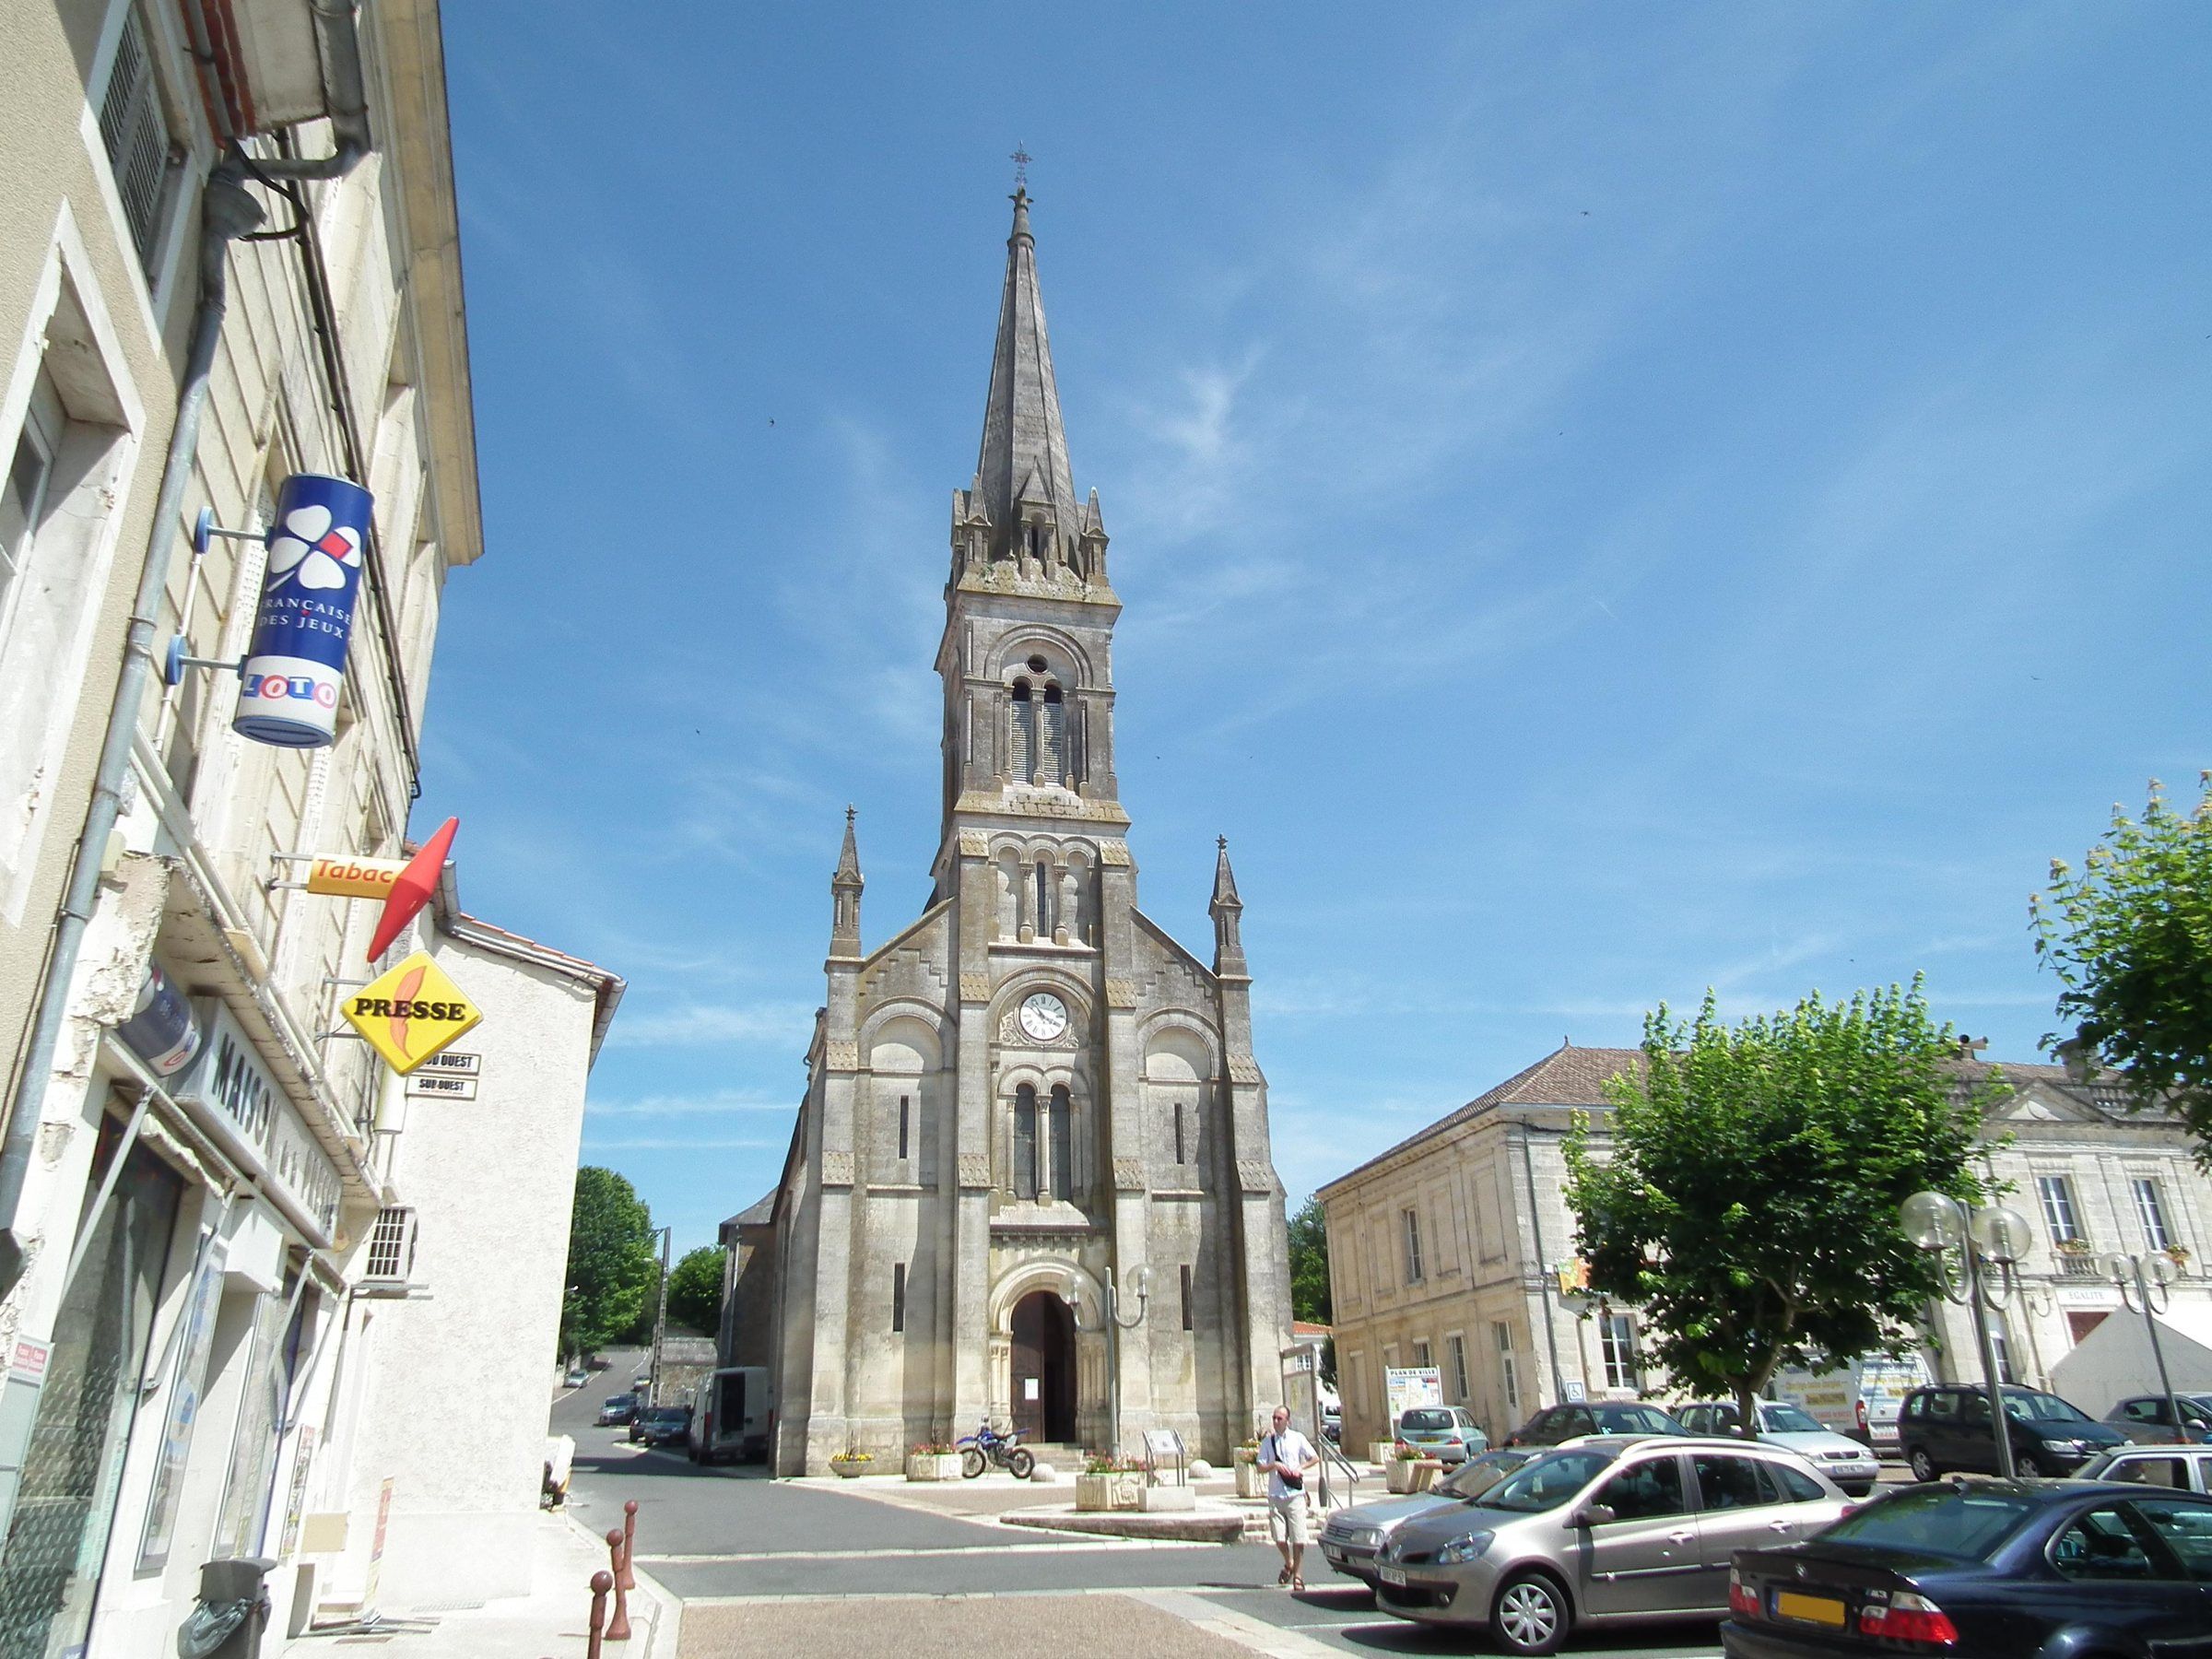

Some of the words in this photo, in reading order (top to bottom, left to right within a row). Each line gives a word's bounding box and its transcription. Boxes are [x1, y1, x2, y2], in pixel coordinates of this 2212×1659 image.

[261, 598, 351, 626] RANÇAISE
[260, 615, 290, 627] DES
[296, 617, 345, 640] JEUX
[243, 674, 337, 709] LOTO
[317, 859, 394, 884] Tabac
[354, 998, 466, 1022] PRESSE
[441, 1054, 473, 1068] OUEST
[212, 1031, 278, 1159] MAISON
